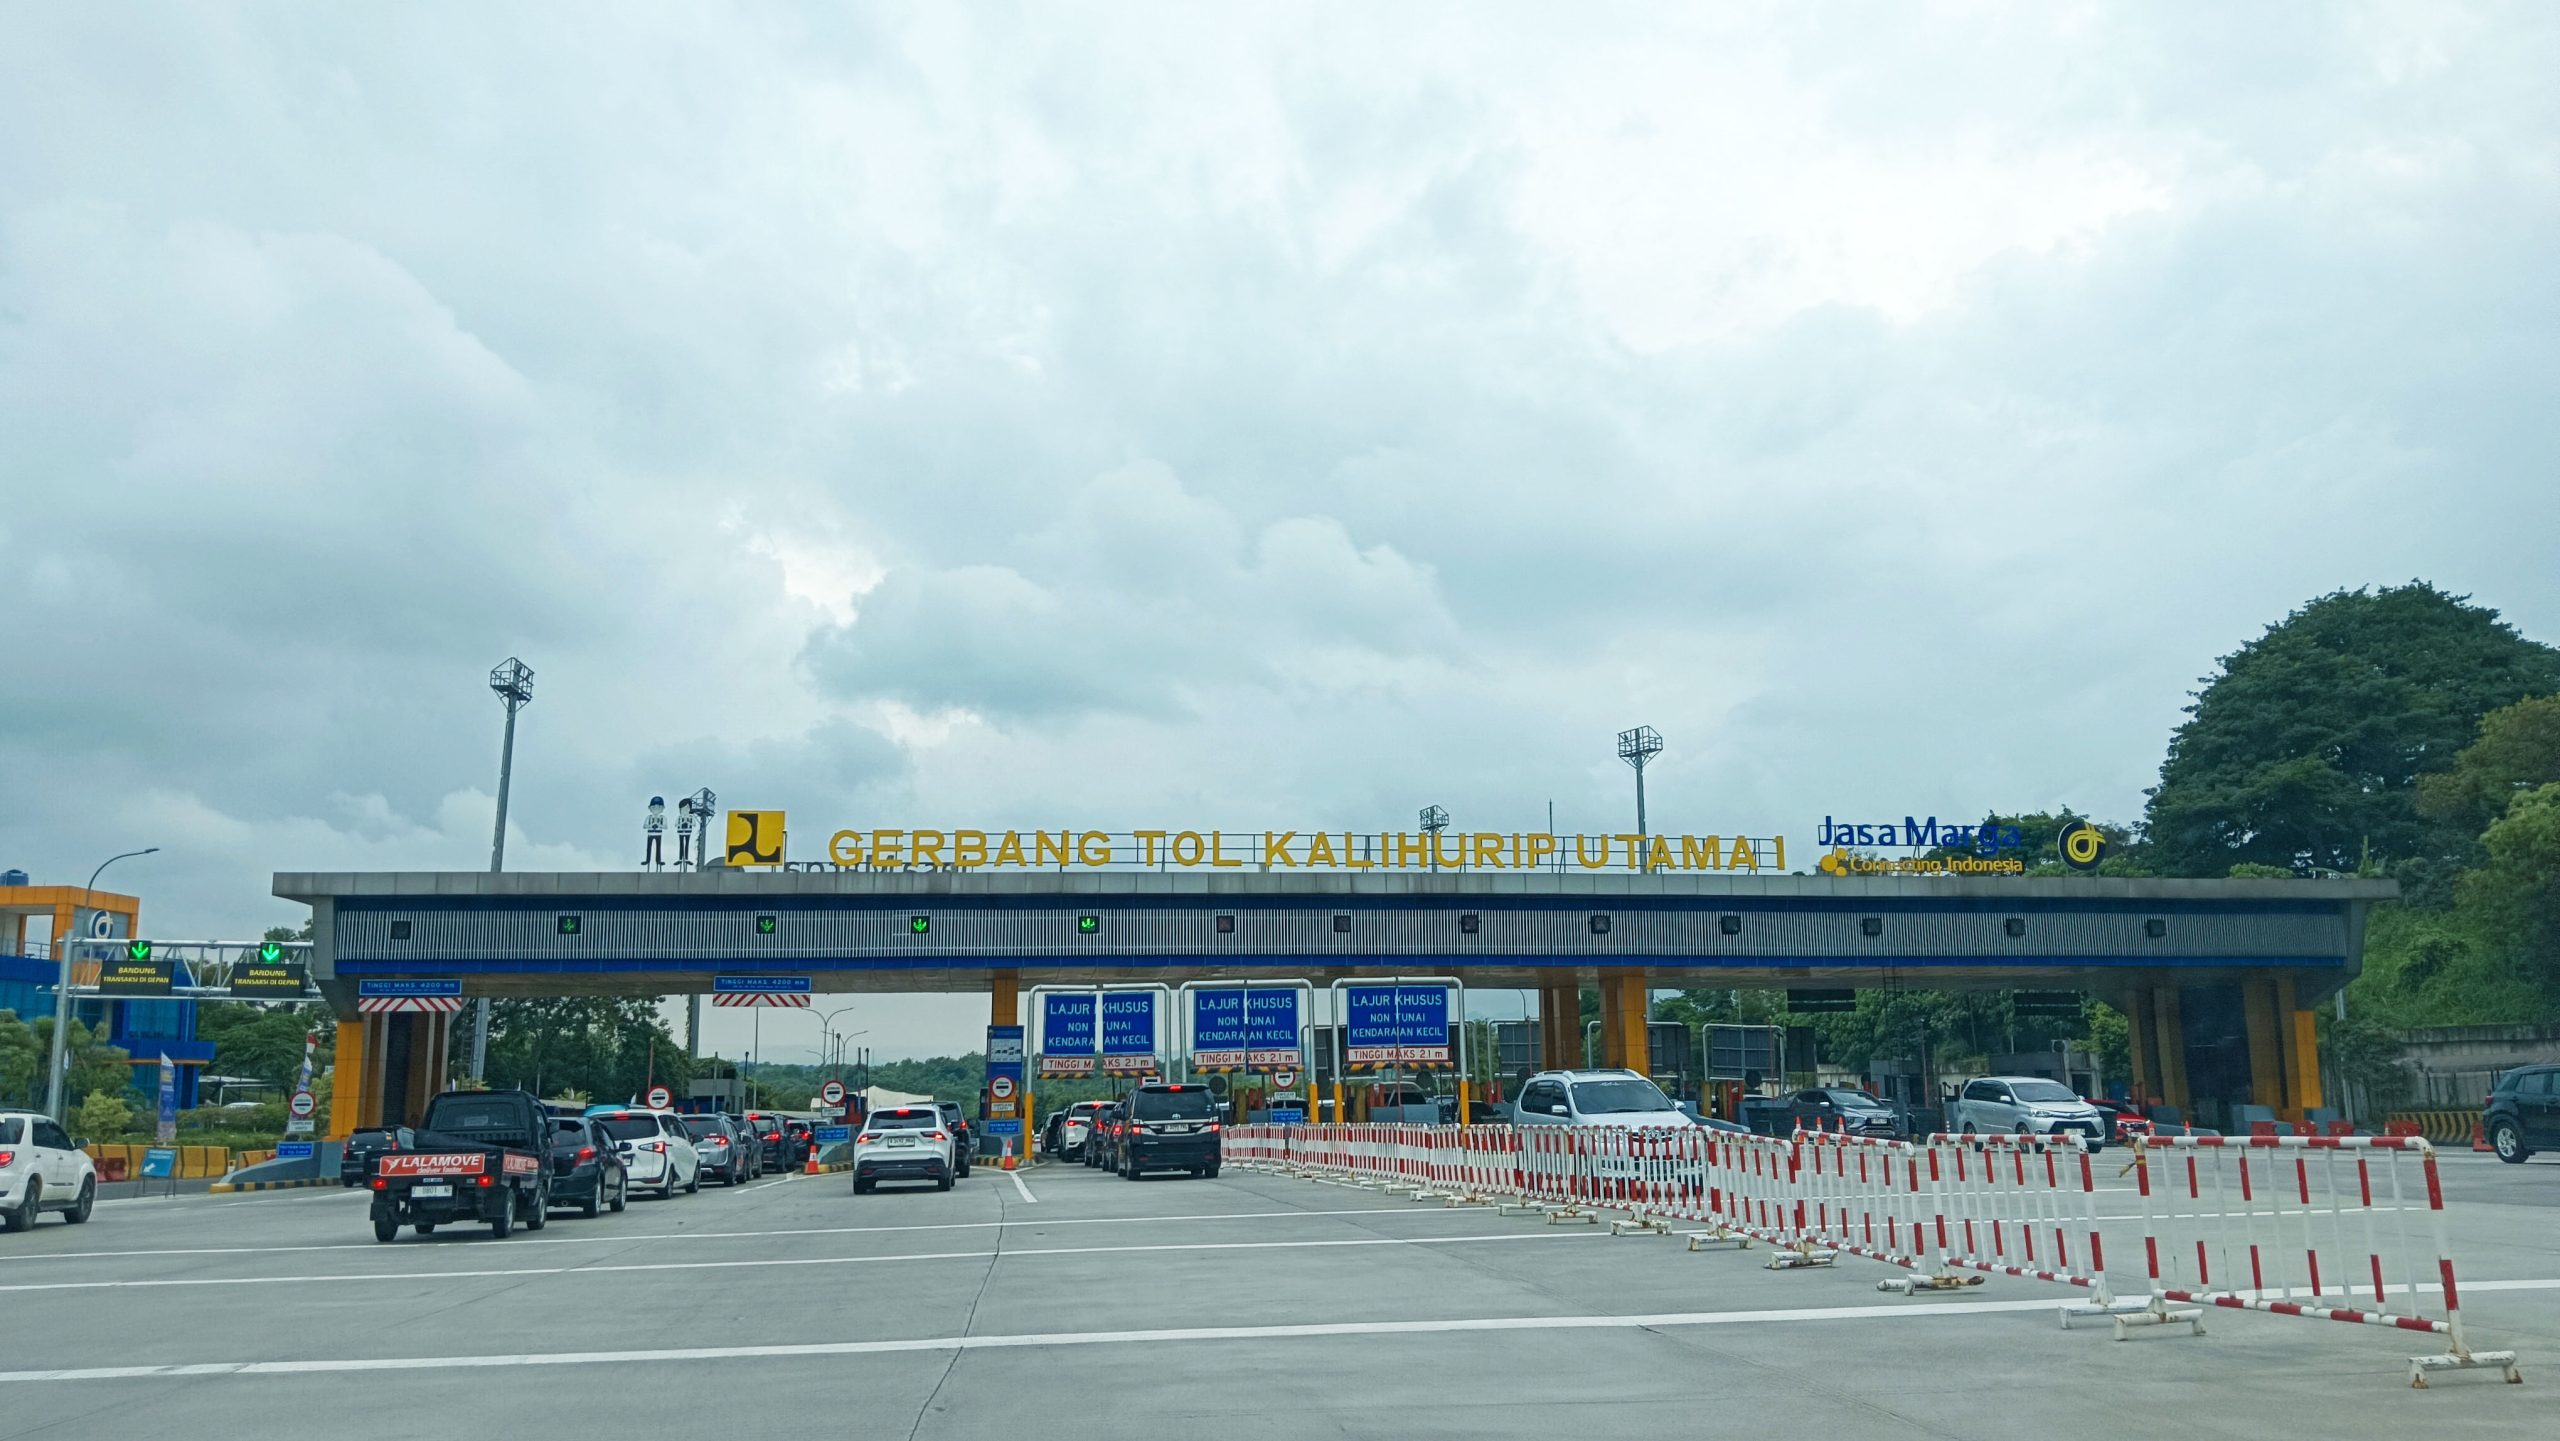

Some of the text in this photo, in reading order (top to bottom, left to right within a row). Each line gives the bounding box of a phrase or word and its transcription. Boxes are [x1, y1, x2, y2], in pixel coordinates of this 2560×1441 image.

[1818, 816, 2021, 855] Jasa Marga
[828, 829, 1112, 868] GERBANG
[1133, 829, 1242, 868] TOL
[1265, 830, 1557, 870] KALIHURIP
[1576, 833, 1759, 871] UTAMA
[1772, 836, 1786, 871] 1
[1850, 855, 2023, 876] Connecting Indonesia
[249, 969, 287, 977] BANDUNG
[1199, 997, 1293, 1010] LAJUR KHUSUS
[1352, 994, 1442, 1007] LAJUR KHUSUS
[1050, 1001, 1149, 1015] LAJUR KHUSUS
[1217, 1016, 1238, 1026] NON
[1370, 1013, 1390, 1023] NON
[1067, 1021, 1131, 1032] NON UNAI
[1199, 1030, 1294, 1041] KENDARAAN KECIL
[1352, 1027, 1443, 1038] KENDARAAN KECIL
[1048, 1034, 1150, 1047] KENDARAAN KECIL
[1200, 1054, 1231, 1063] TINGGI
[1285, 1054, 1294, 1062] m
[1354, 1050, 1384, 1060] TINGGI
[1386, 1049, 1416, 1059] MAKS
[1048, 1059, 1080, 1069] TINGGI
[401, 1155, 481, 1168] LALAMOVE
